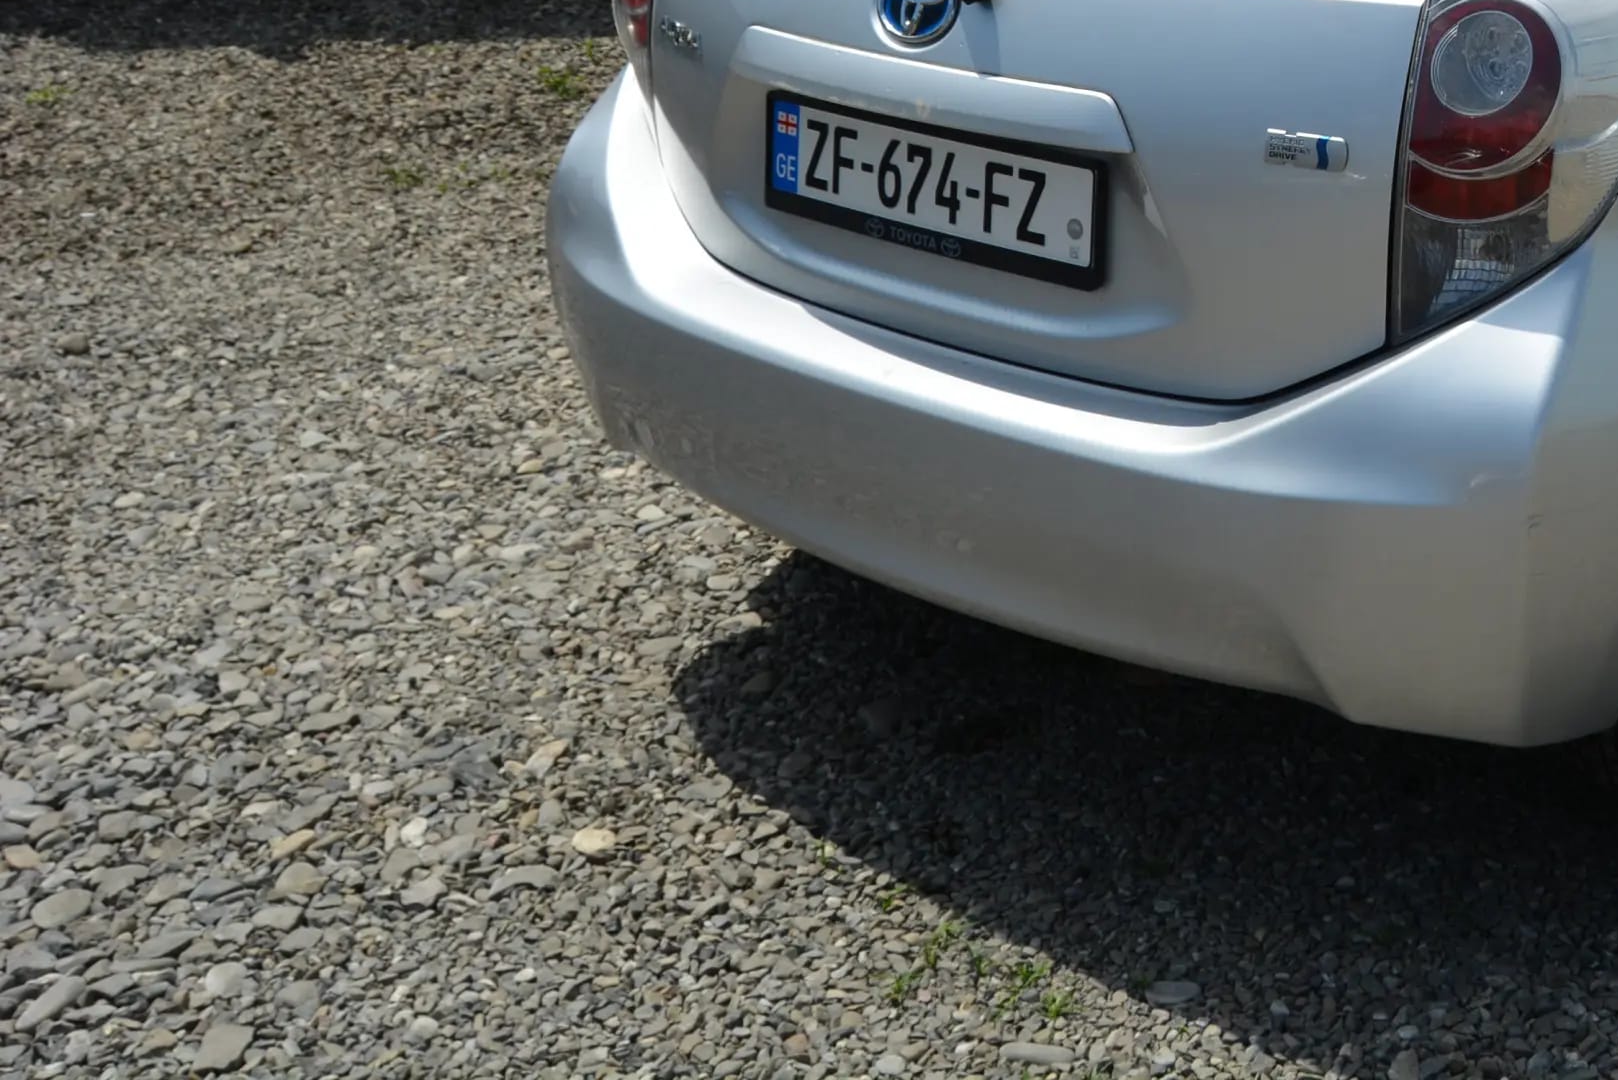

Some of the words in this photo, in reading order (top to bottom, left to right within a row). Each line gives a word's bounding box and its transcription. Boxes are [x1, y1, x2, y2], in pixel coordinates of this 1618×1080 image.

[776, 152, 797, 182] GE
[1268, 151, 1297, 161] DRIVE
[805, 119, 1047, 246] ZF-674-FZ
[889, 225, 937, 251] TOYOTA
